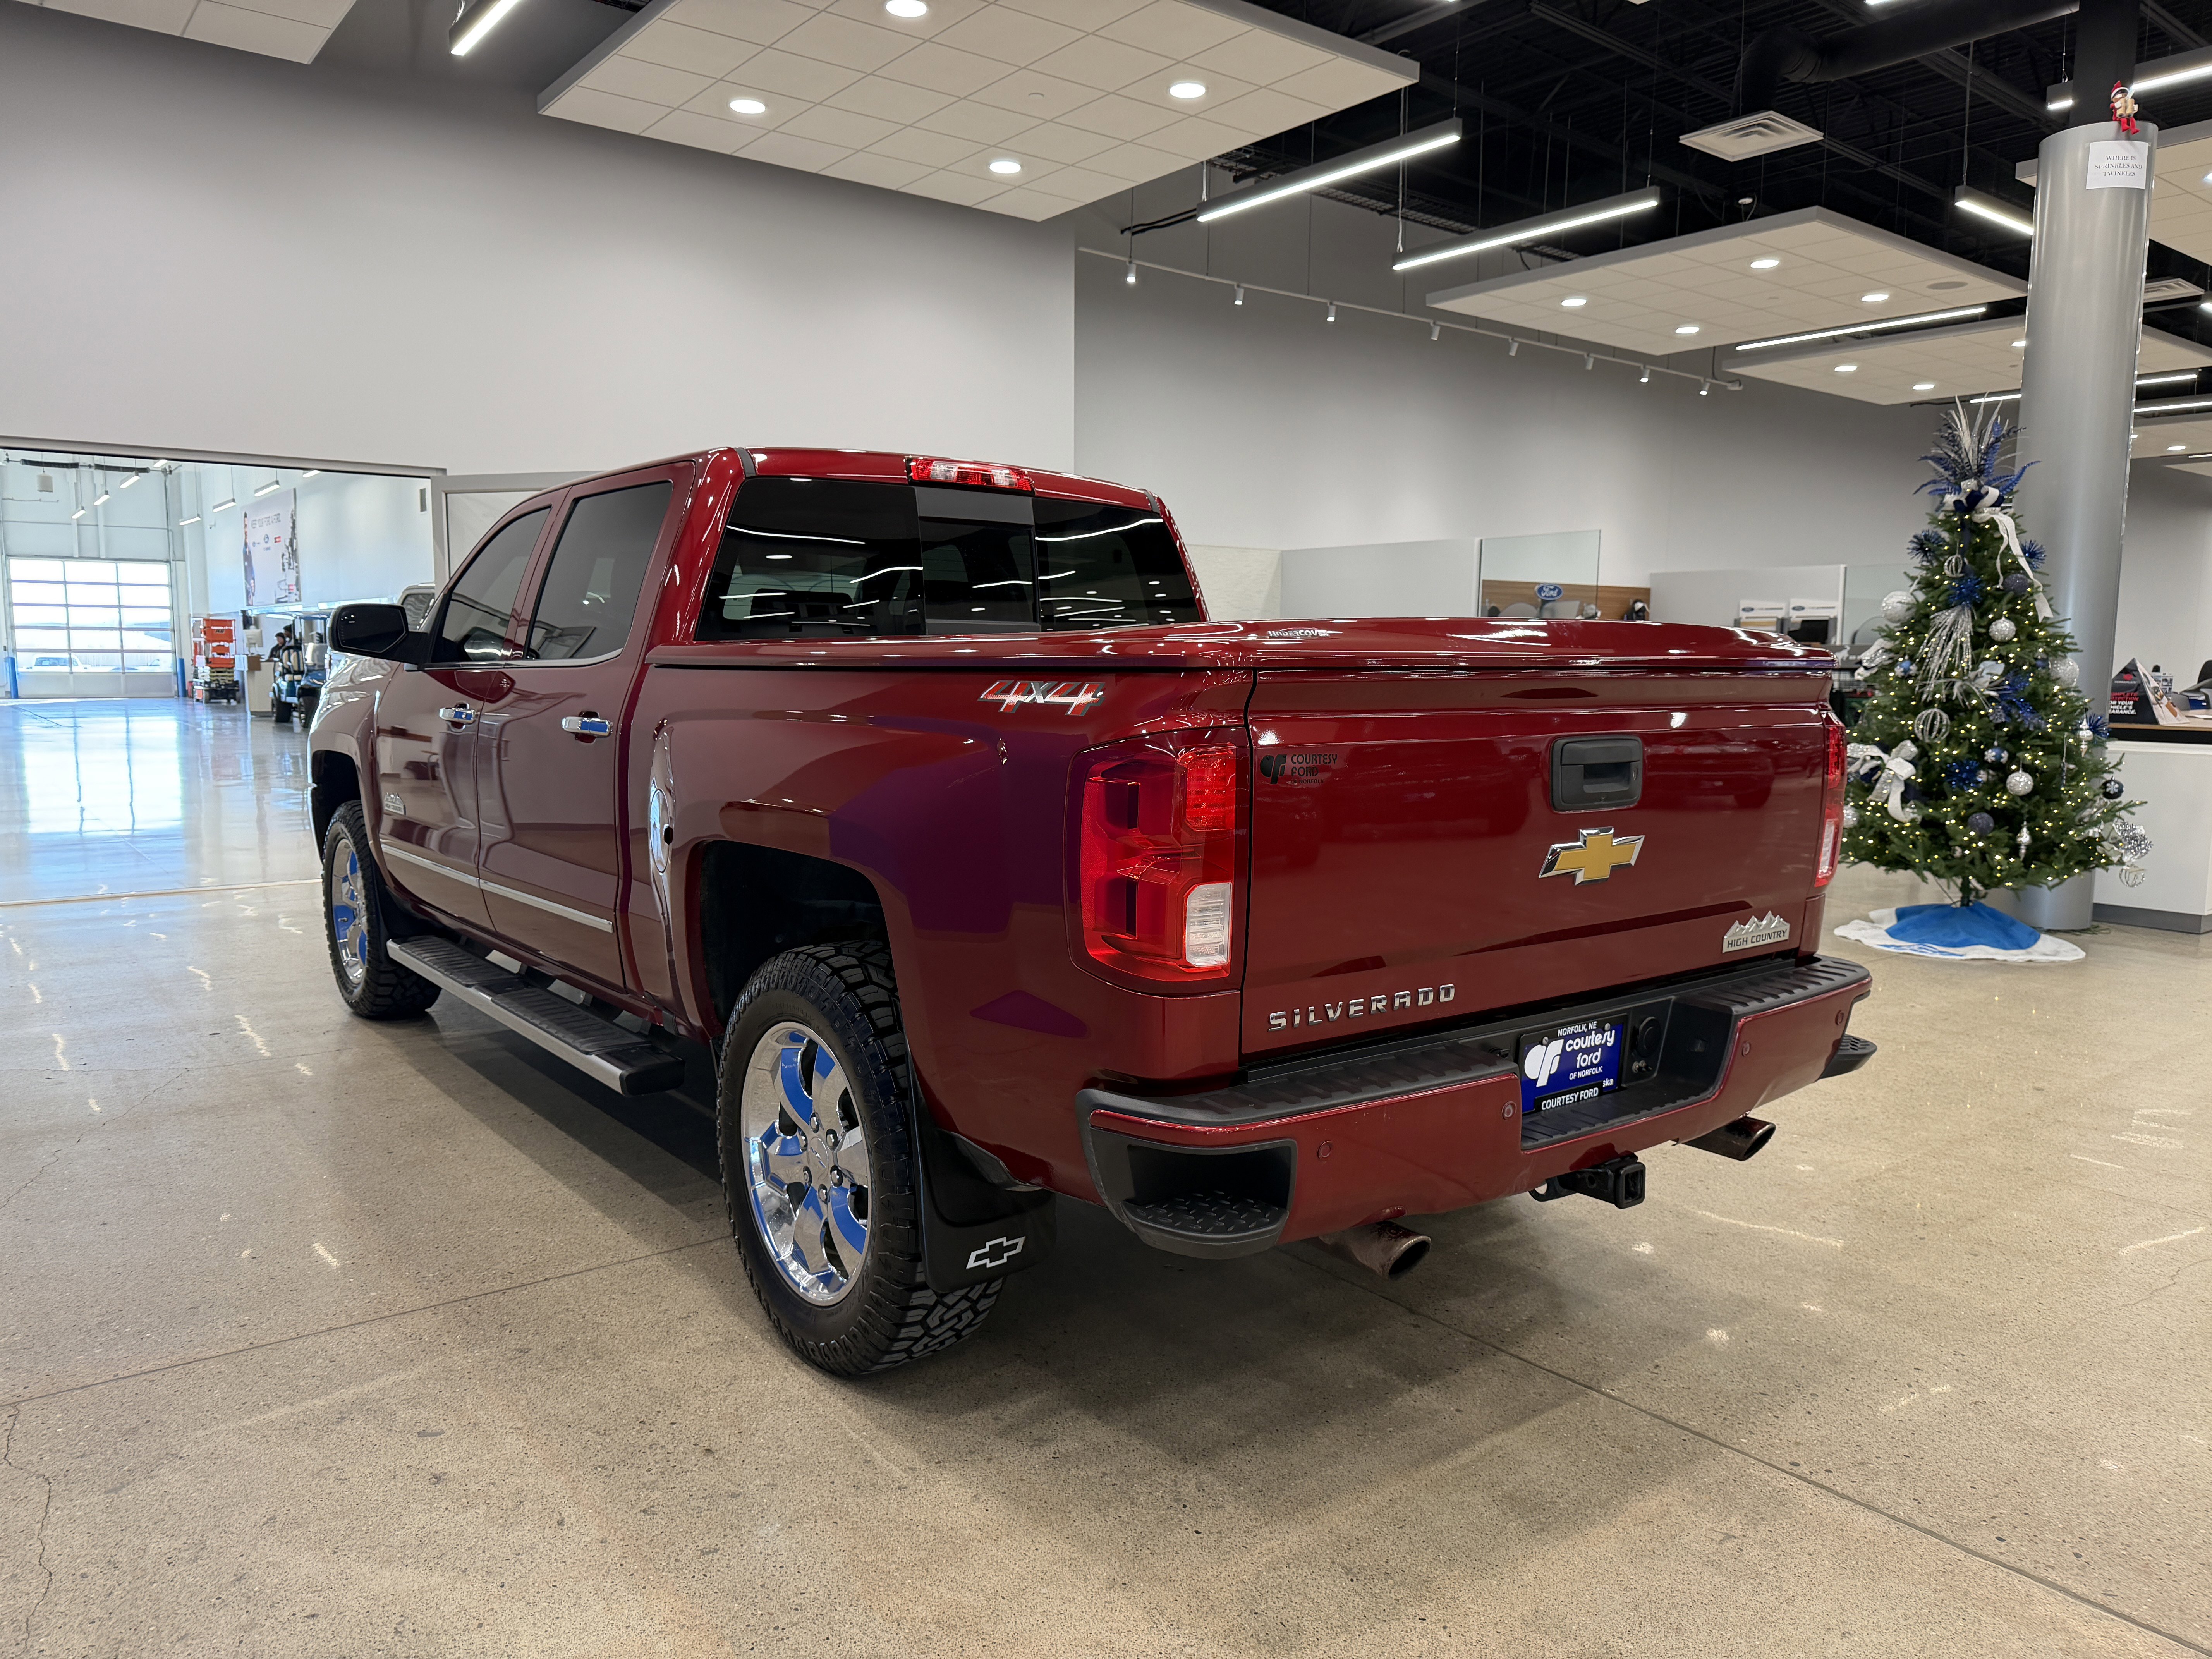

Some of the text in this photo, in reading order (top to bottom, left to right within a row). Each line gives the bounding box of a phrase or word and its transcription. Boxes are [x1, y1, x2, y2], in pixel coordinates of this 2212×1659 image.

[1291, 754, 1337, 764] COURTESY
[1291, 767, 1319, 776] FORD
[1727, 929, 1787, 948] HIGH COUNTRY
[1267, 984, 1455, 1032] SILVERADO
[1558, 1021, 1597, 1037] NORFOLK, NE
[1566, 1030, 1615, 1052] courtesy
[1577, 1048, 1602, 1068] ford
[1569, 1066, 1603, 1080] OF NORFOLK
[1541, 1087, 1599, 1110] COURTESY FORD
